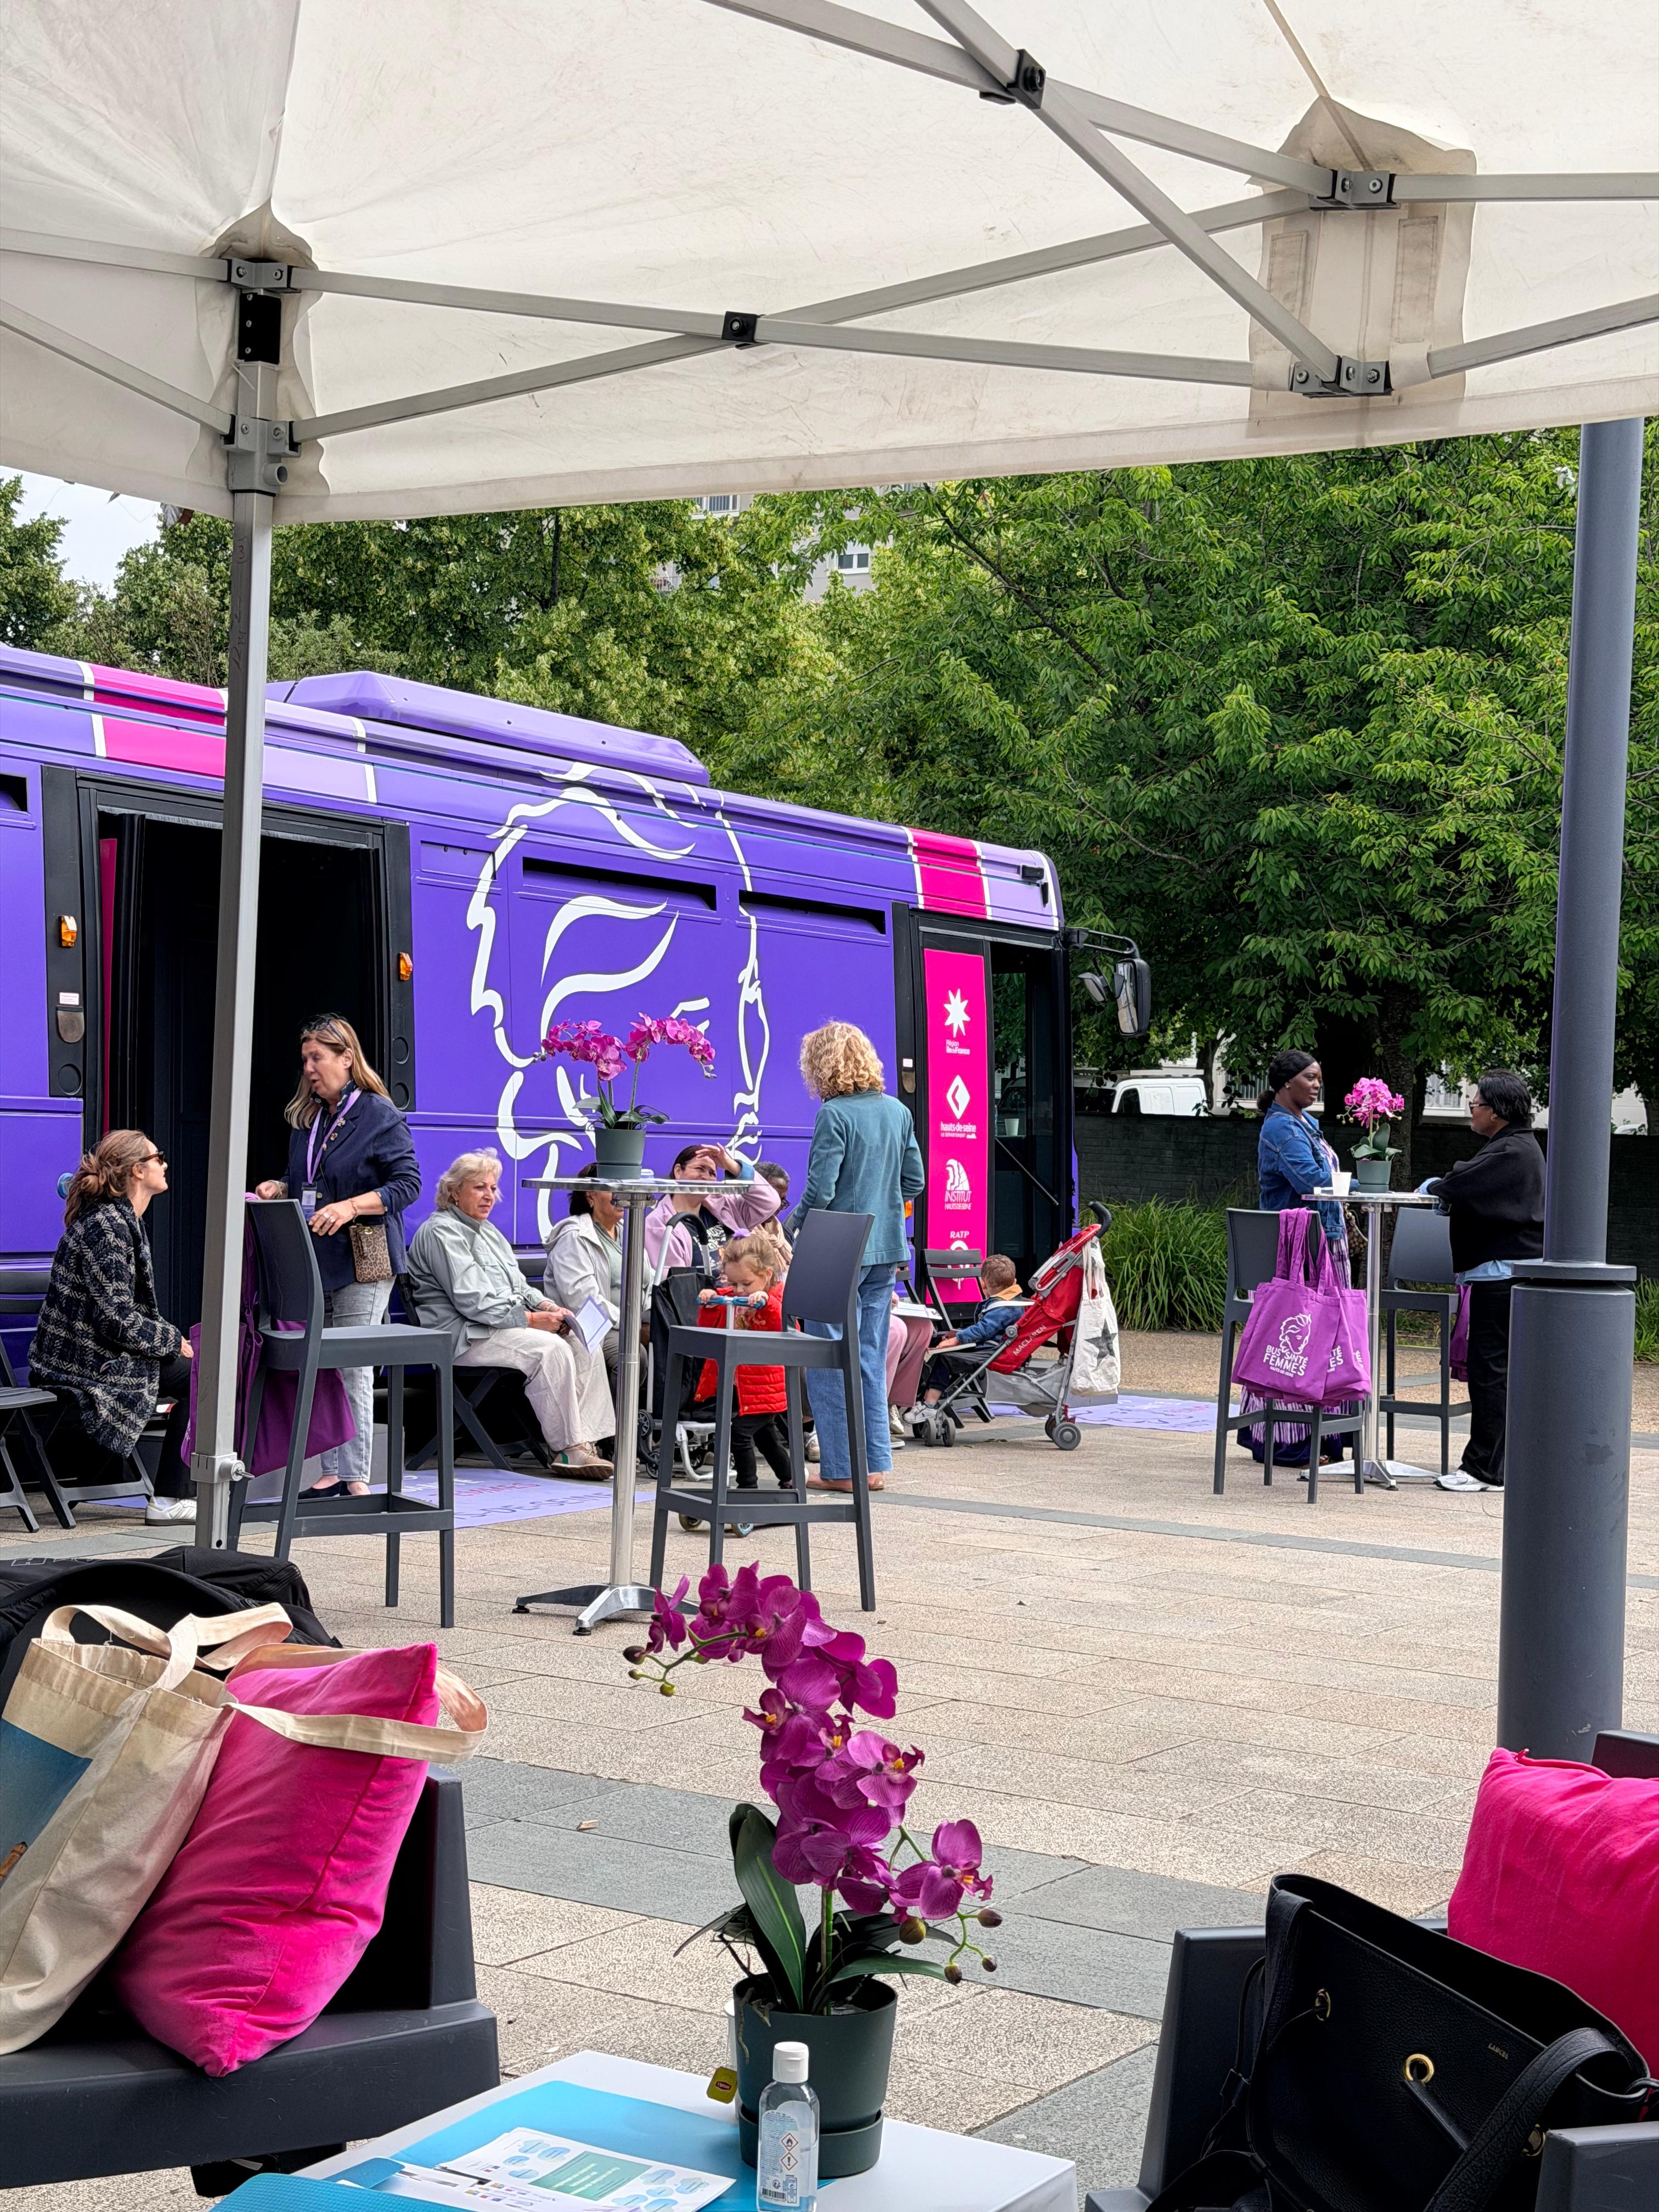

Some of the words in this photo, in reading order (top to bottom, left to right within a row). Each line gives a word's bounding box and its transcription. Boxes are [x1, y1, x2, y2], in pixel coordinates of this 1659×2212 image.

[944, 1190, 972, 1203] INSTITUT
[950, 1231, 970, 1239] RATP
[1013, 1325, 1047, 1356] MACLAREN
[1263, 1353, 1306, 1376] FEMMES
[1266, 1345, 1282, 1357] BUS
[1284, 1351, 1308, 1367] SANTÉ
